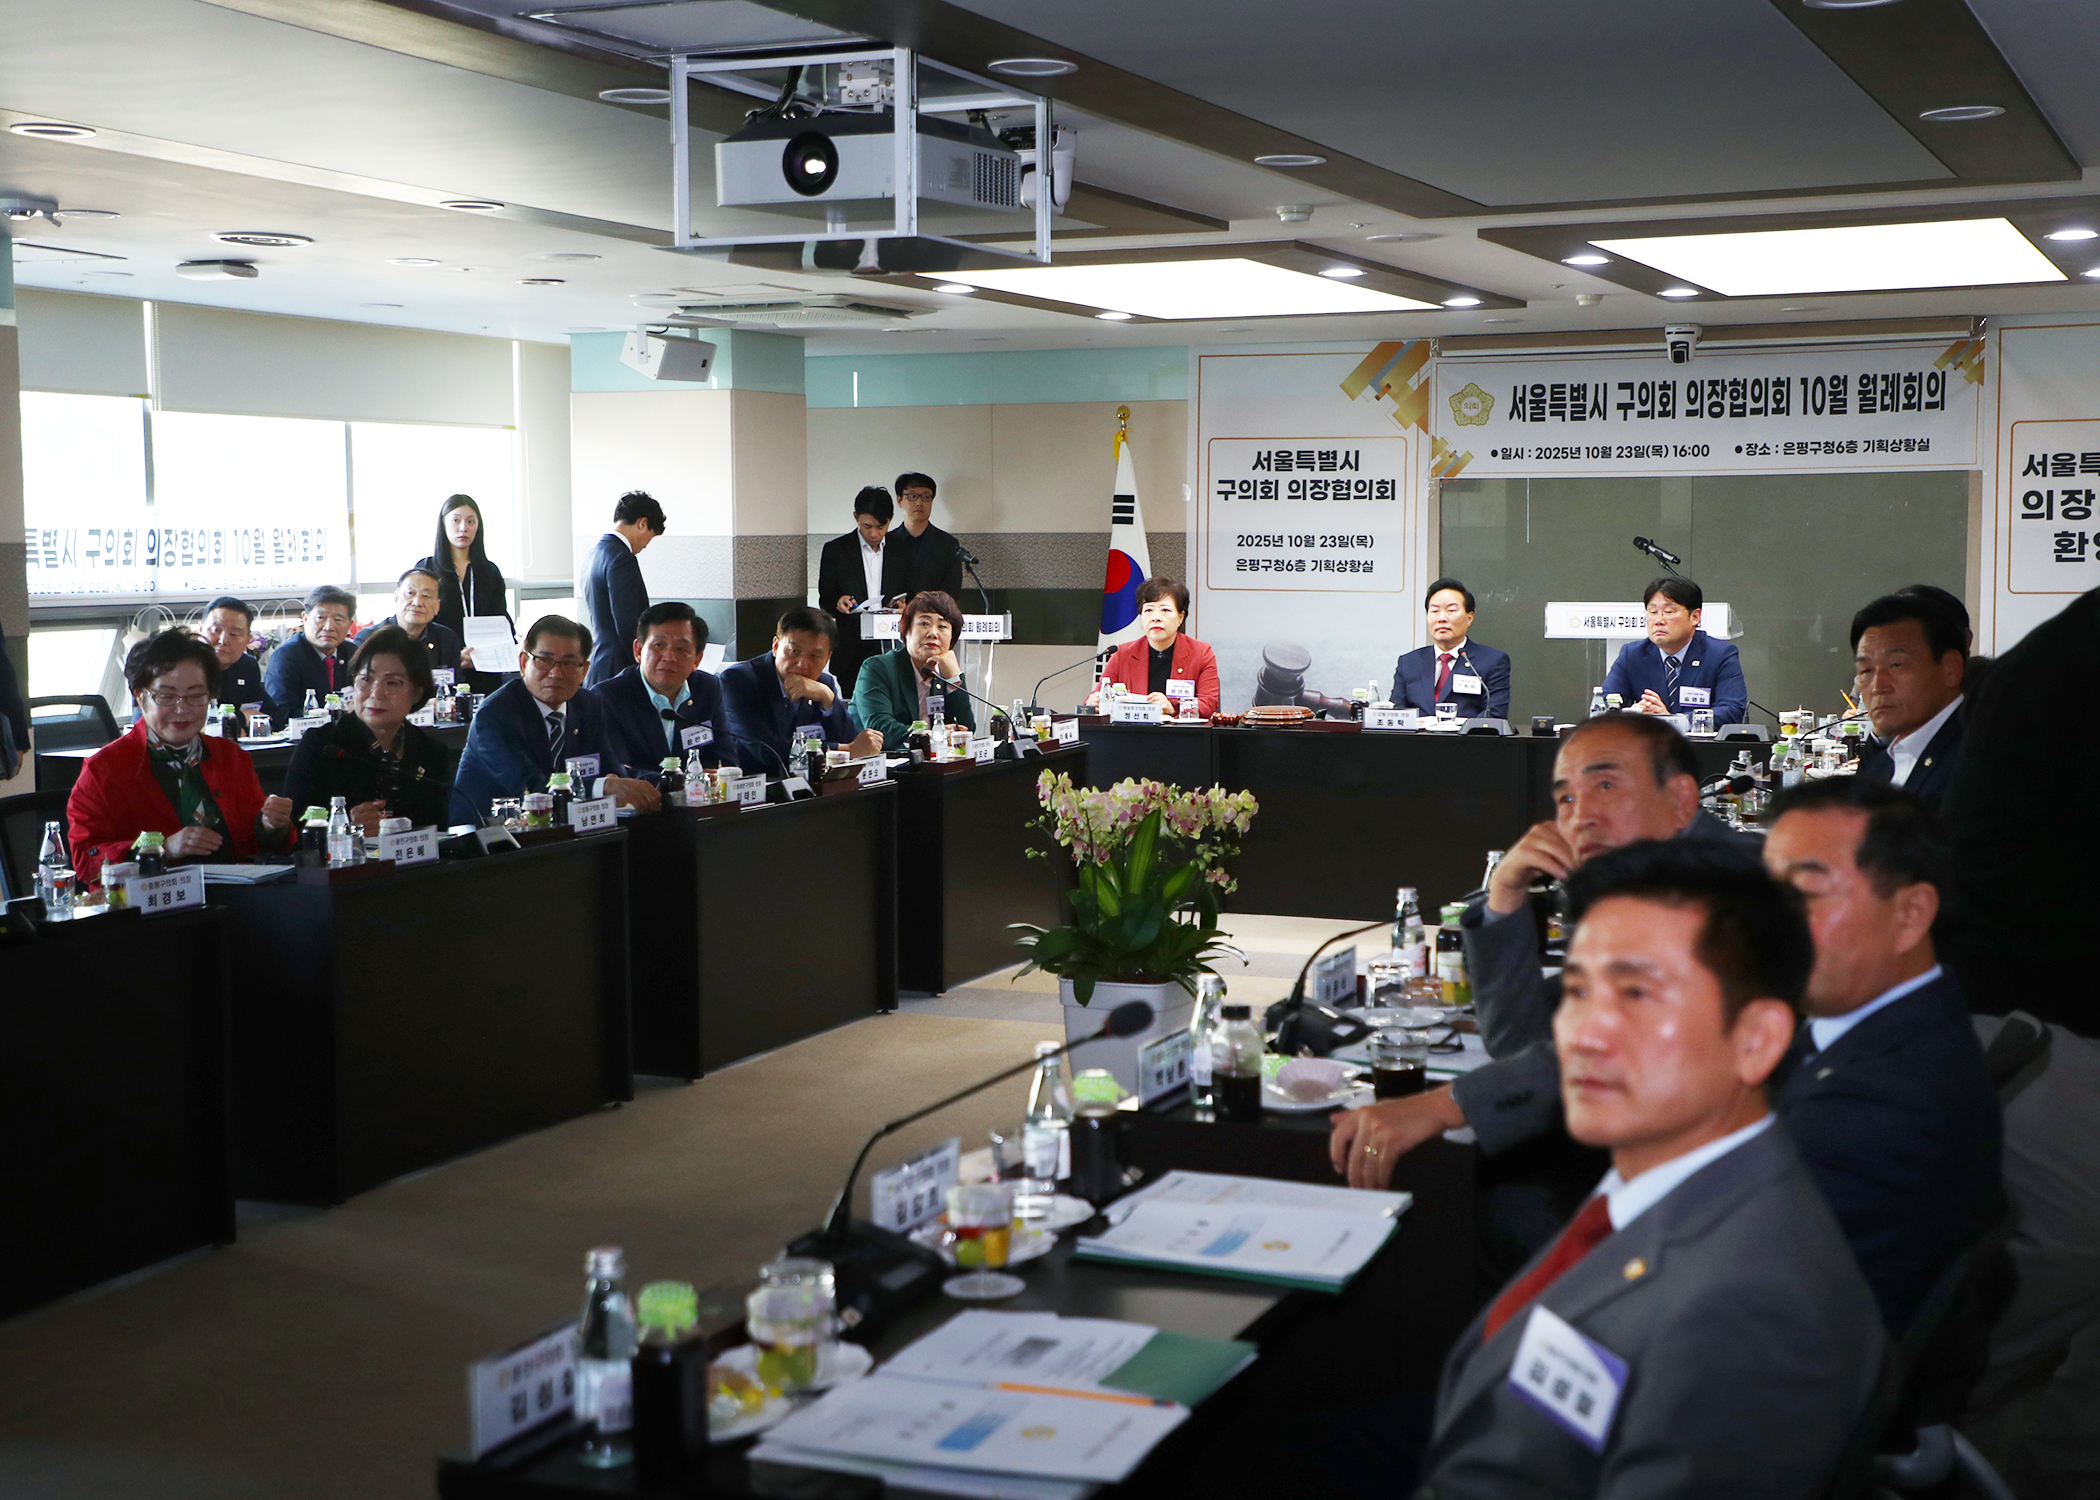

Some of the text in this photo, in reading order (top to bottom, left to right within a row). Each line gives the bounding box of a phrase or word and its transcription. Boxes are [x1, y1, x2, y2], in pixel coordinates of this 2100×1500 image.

[1508, 370, 1947, 423] 서울특별시 구의회 의장협의회 10월 월례회의
[1463, 400, 1480, 411] 의회
[1500, 447, 1524, 460] 일시
[1535, 446, 1581, 460] 2025년
[1585, 445, 1612, 459] 10월
[1616, 444, 1669, 459] 23일(목)
[1672, 444, 1710, 458] 16:00
[1745, 442, 1771, 457] 장소
[1782, 439, 1858, 456] 은평구청6층
[1862, 437, 1930, 453] 기획상황실
[1252, 449, 1360, 472] 서울특별시
[2022, 451, 2100, 478] 서울특
[1216, 478, 1396, 501] 구의회 의장협의회
[86, 528, 137, 568] 구의회
[232, 528, 265, 565] 10월
[1236, 534, 1374, 549] 2025년 10월 23일(목)
[2053, 530, 2100, 563] 환
[1236, 558, 1374, 573] 은평구청6층 기획상황실
[890, 620, 901, 633] 서
[1583, 616, 1616, 628] 서울특별시
[1618, 616, 1637, 628] 구의회
[1124, 712, 1150, 720] 정선희
[1377, 719, 1404, 727] 조동탁
[179, 875, 192, 884] 의장
[147, 889, 187, 907] 최경보
